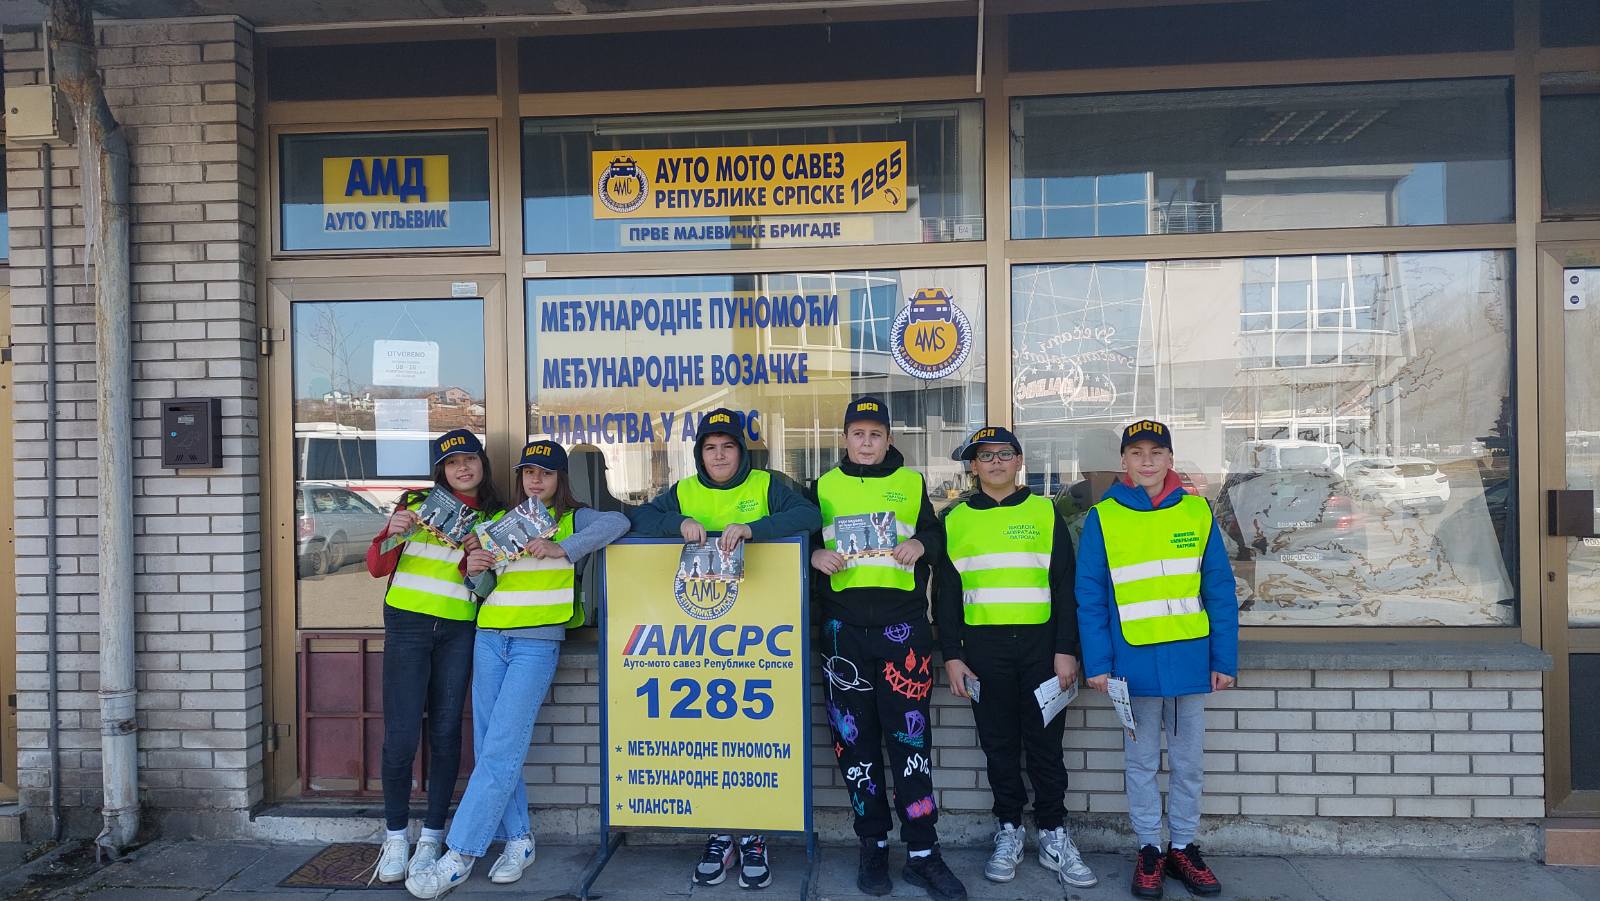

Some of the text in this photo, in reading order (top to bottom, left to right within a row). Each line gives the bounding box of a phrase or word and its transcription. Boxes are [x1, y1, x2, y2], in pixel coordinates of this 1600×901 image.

[655, 151, 845, 184] АУТО МОТО САВЕЗ
[850, 148, 902, 206] 1285
[345, 158, 427, 203] АМД
[655, 186, 767, 209] РЕПУБЛИКЕ
[773, 182, 845, 206] СРПСКЕ
[325, 209, 447, 230] АУТО УГЉЕВИК
[629, 222, 841, 241] ПРВЕ МАЈЕВИЧКЕ БРИГАДЕ
[541, 295, 838, 336] МЕЂУНАРОДНЕ ПУНОМОЋИ
[915, 325, 945, 352] AMS
[542, 353, 808, 393] МЕЂУНАРОДНЕ ВОЗАЧКЕ
[857, 402, 879, 412] ШСП
[542, 413, 655, 445] ЧЛАНСТВА
[662, 411, 675, 443] У
[709, 413, 730, 424] ШСП
[1128, 421, 1163, 437] ШСП
[440, 435, 466, 453] ШСП
[972, 428, 995, 443] ШСП
[525, 445, 552, 457] ШСП
[638, 624, 794, 657] АМСРС
[623, 658, 794, 670] Ауто-мото савез Републике Српске
[636, 677, 774, 720] 1285
[628, 740, 791, 760] МЕЂУНАРОДНЕ ПУНОМОЋИ
[628, 769, 779, 790] МЕЂУНАРОДНЕ ДОЗВОЛЕ
[628, 798, 692, 815] ЧЛАНСТВА
